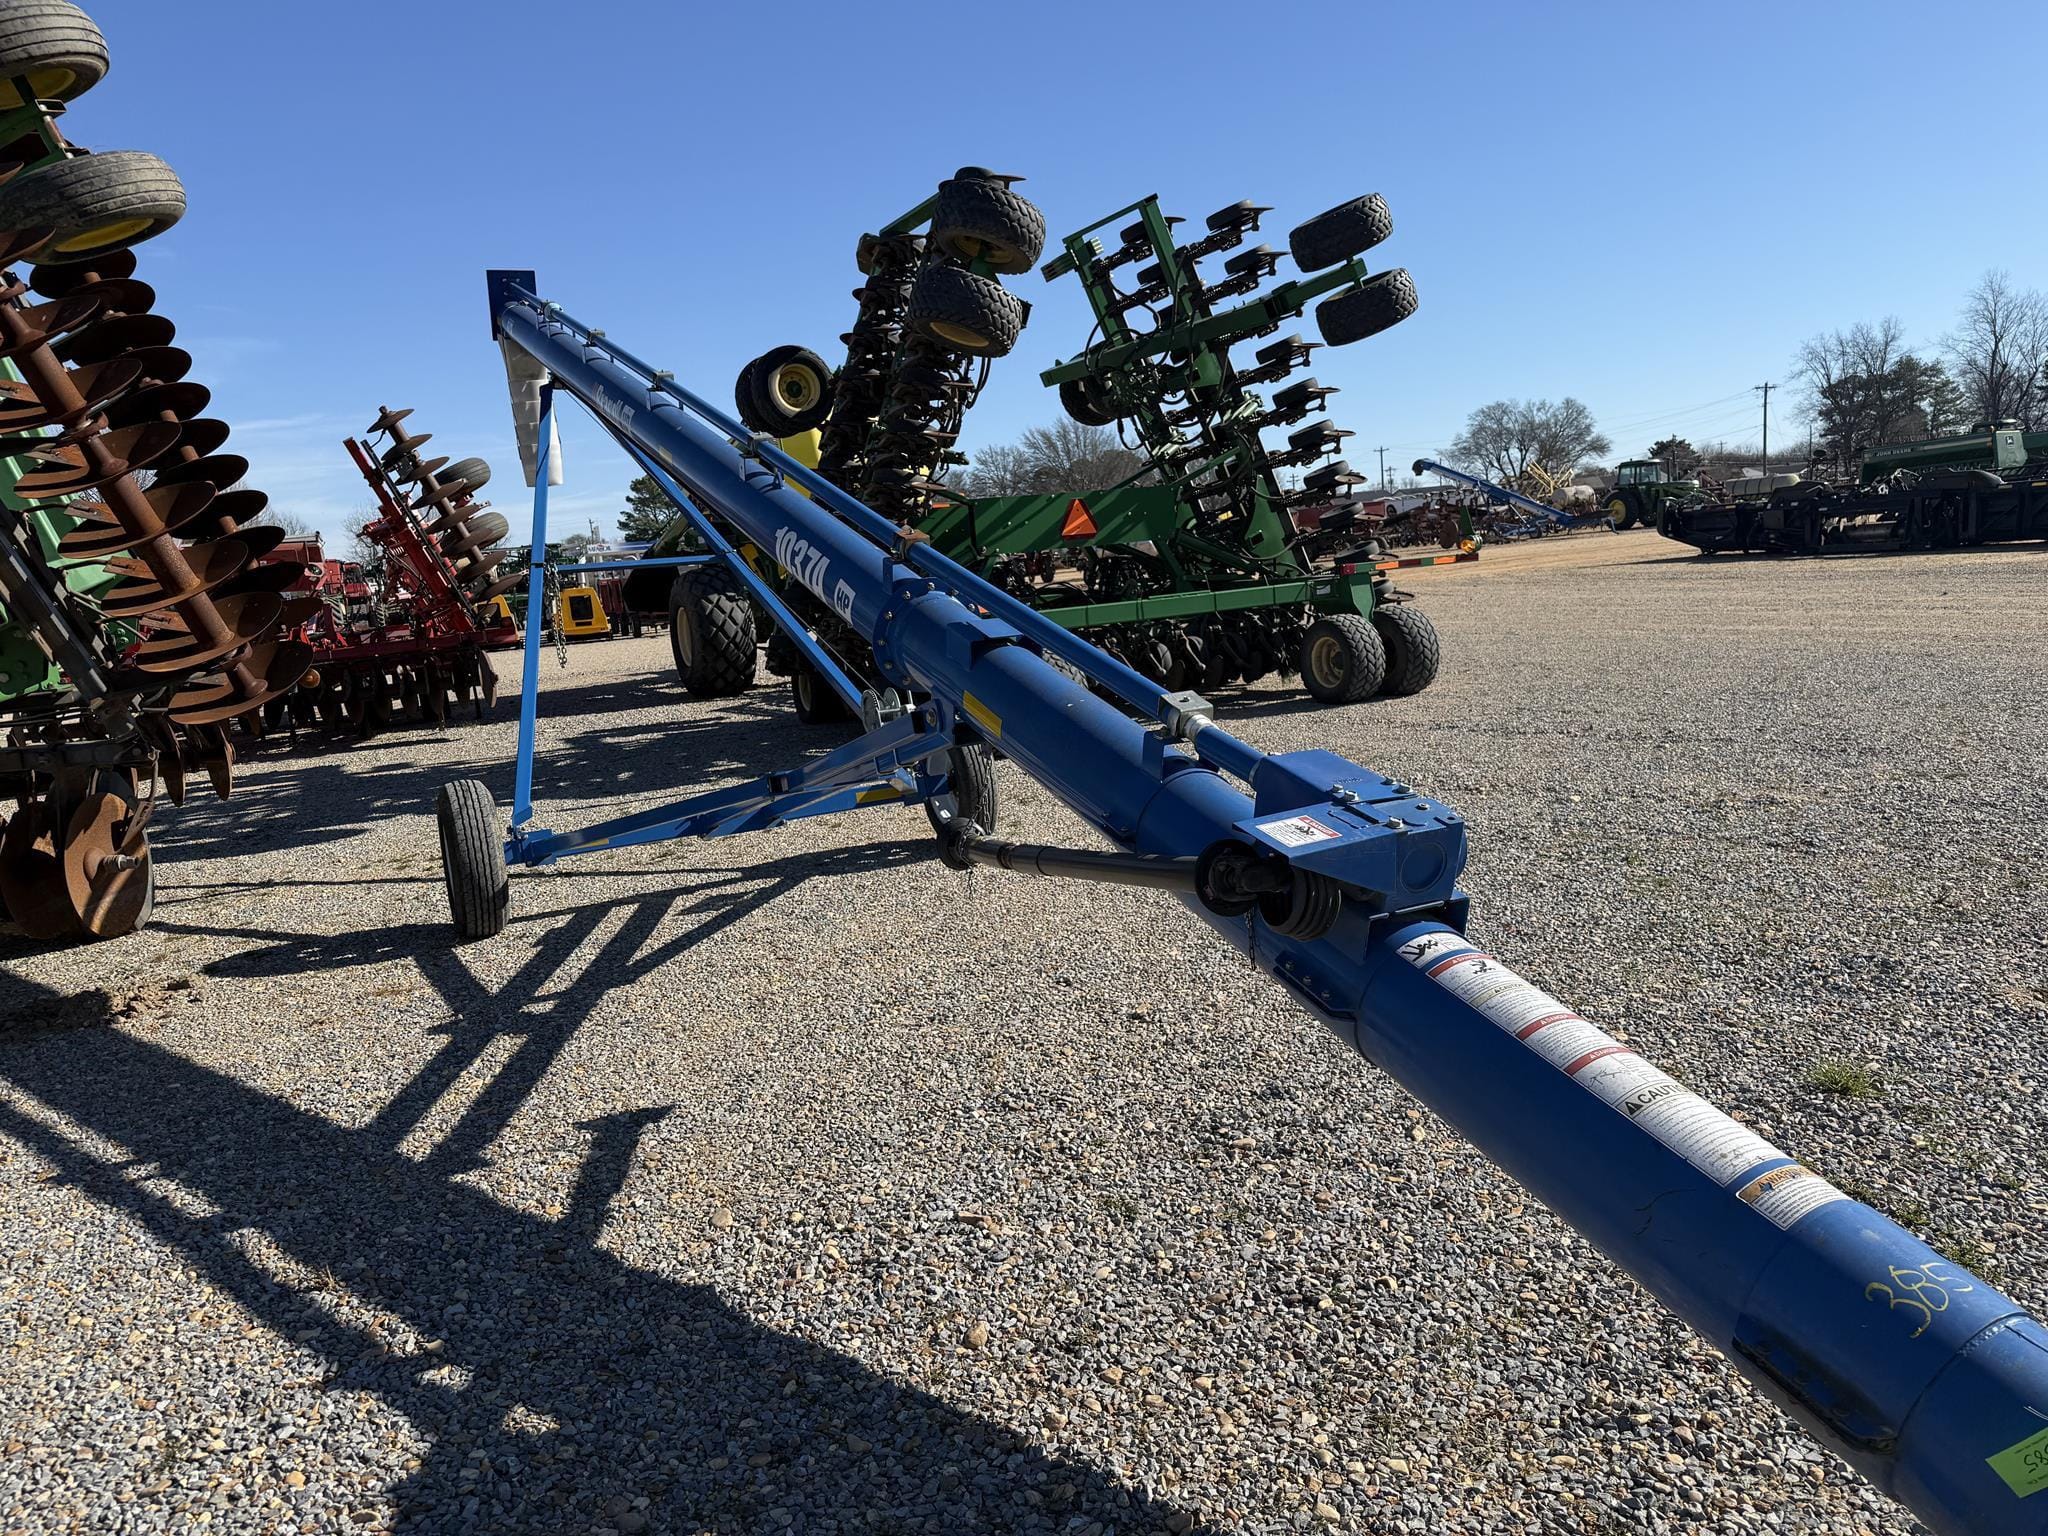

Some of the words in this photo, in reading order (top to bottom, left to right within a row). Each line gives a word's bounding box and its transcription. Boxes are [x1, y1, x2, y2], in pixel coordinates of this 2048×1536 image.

[775, 526, 831, 602] 1037A
[1637, 1084, 1683, 1104] CAUTI
[1865, 1262, 1974, 1339] 385
